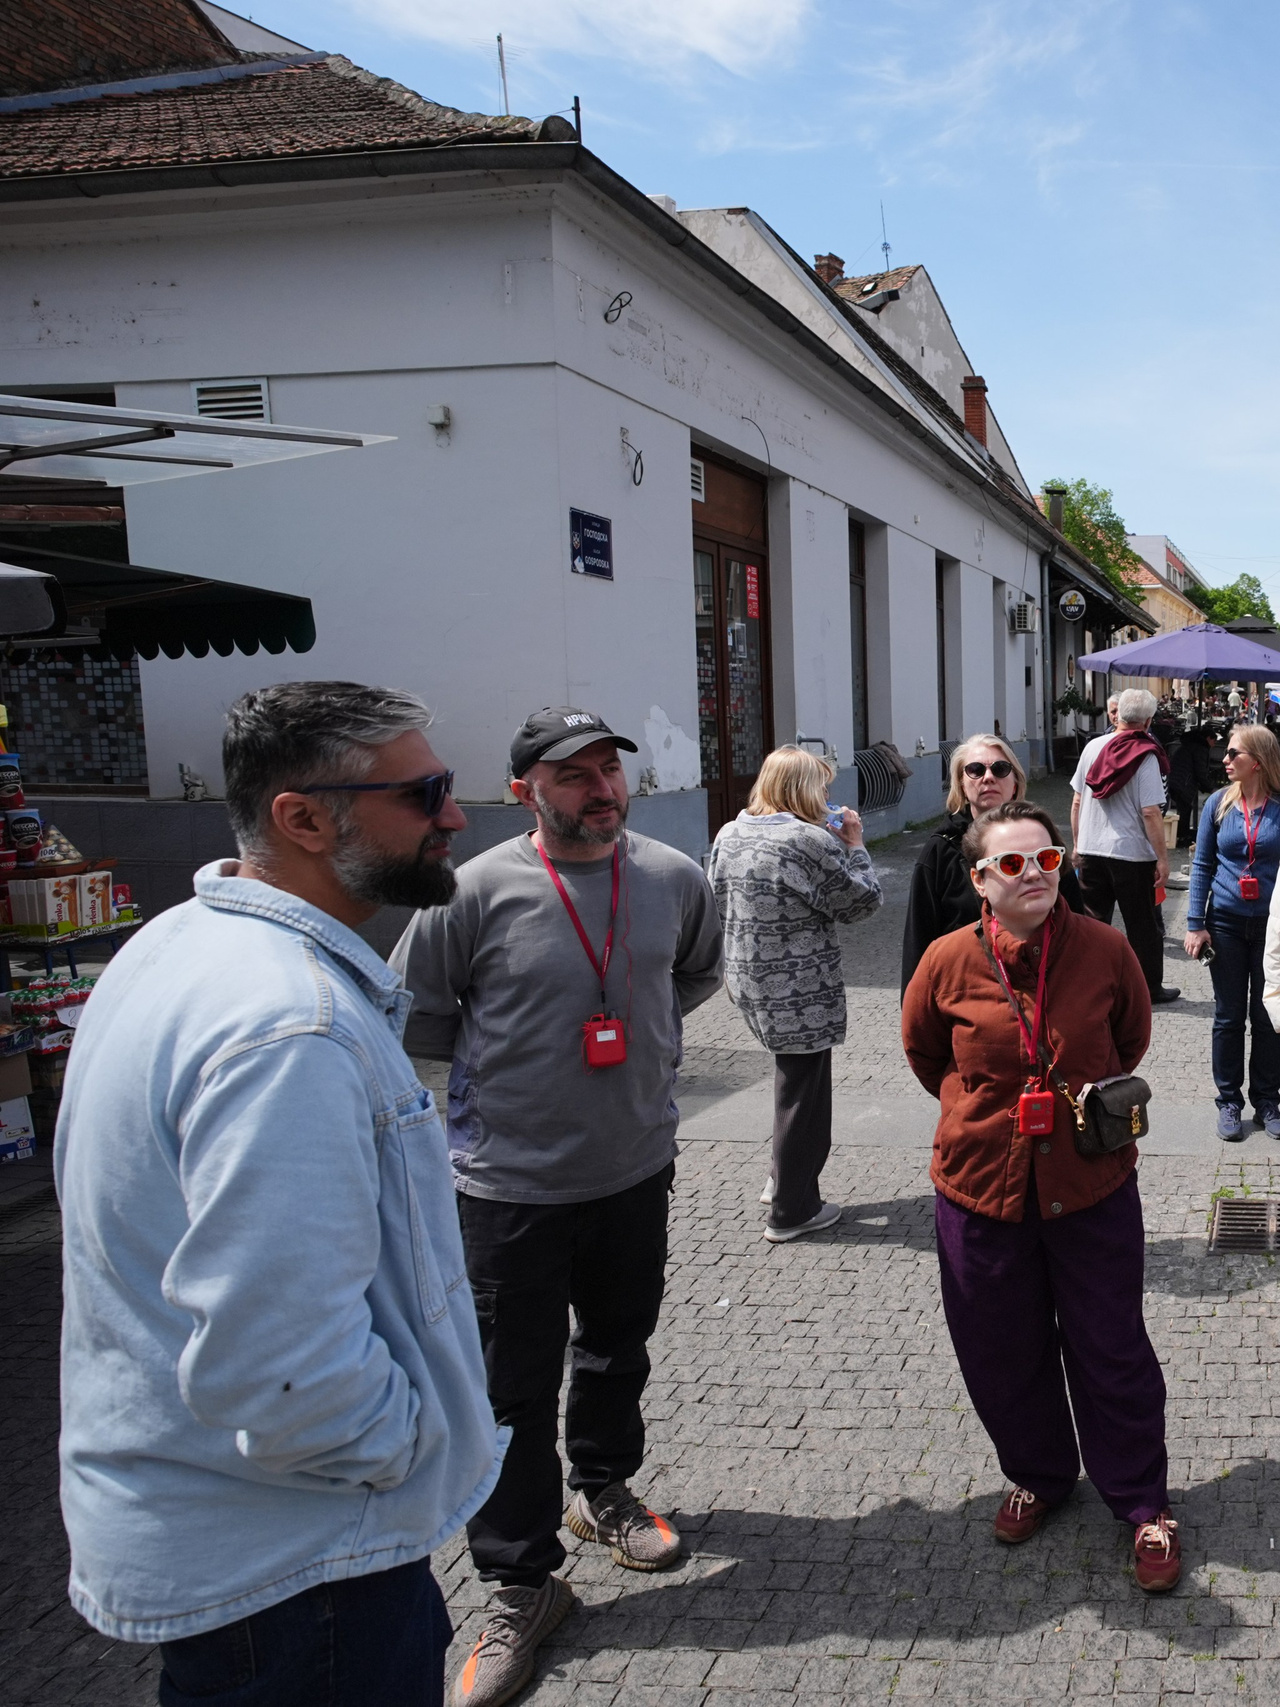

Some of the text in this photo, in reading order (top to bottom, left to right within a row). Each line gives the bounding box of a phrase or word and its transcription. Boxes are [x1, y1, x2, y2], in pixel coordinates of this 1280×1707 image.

[583, 528, 608, 543] ГОСПОДСКА
[584, 555, 610, 569] GOSPODSKA
[54, 902, 63, 922] enka
